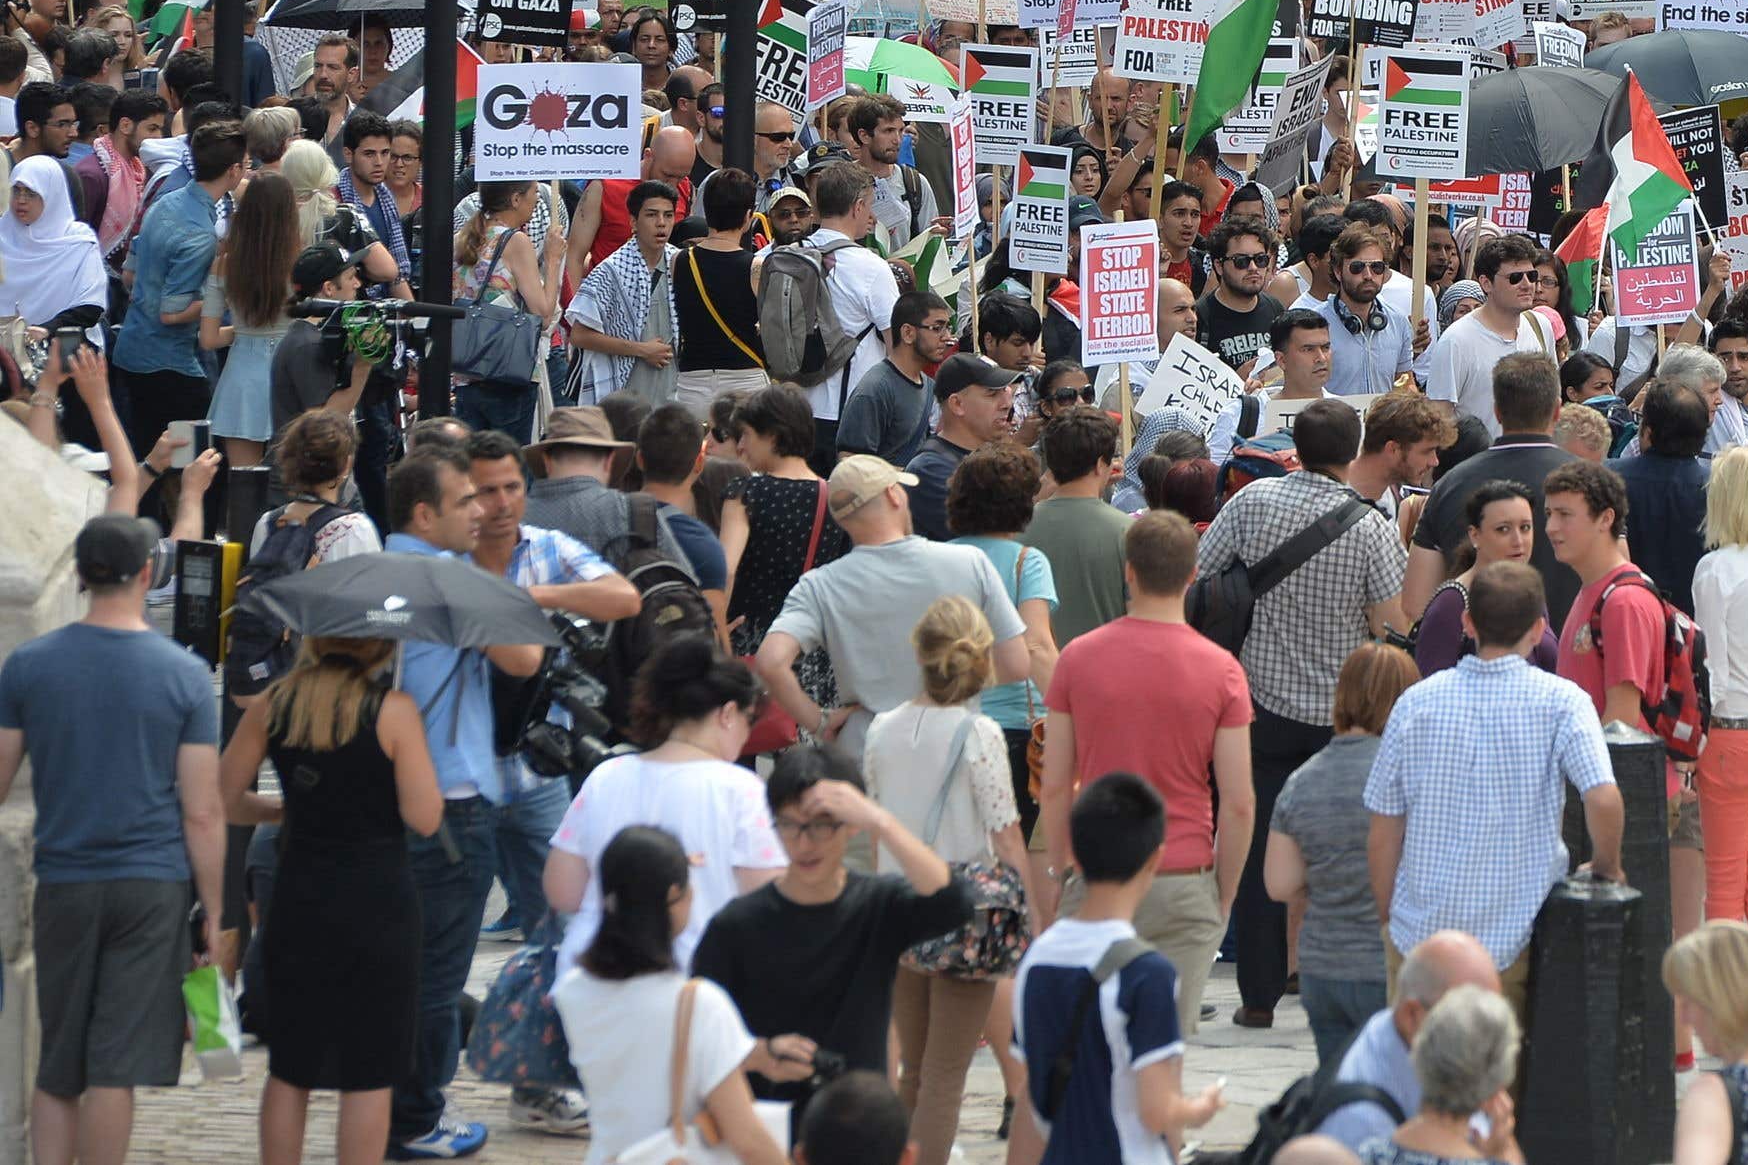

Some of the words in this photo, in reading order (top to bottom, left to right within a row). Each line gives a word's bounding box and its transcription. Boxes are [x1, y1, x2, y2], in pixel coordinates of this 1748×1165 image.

[1385, 109, 1459, 129] FREE
[1385, 127, 1457, 143] PALESTINE
[483, 142, 517, 158] Stop
[523, 142, 547, 156] the
[551, 144, 629, 156] massacre
[1015, 203, 1064, 222] FREE
[1015, 221, 1063, 236] PALESTINE
[1102, 246, 1141, 268] STOP
[1094, 268, 1148, 292] ISRAELI
[1626, 271, 1687, 293] لفلسطين
[1100, 291, 1145, 315] STATE
[1635, 290, 1684, 310] الحرية
[1093, 315, 1151, 340] TERROR
